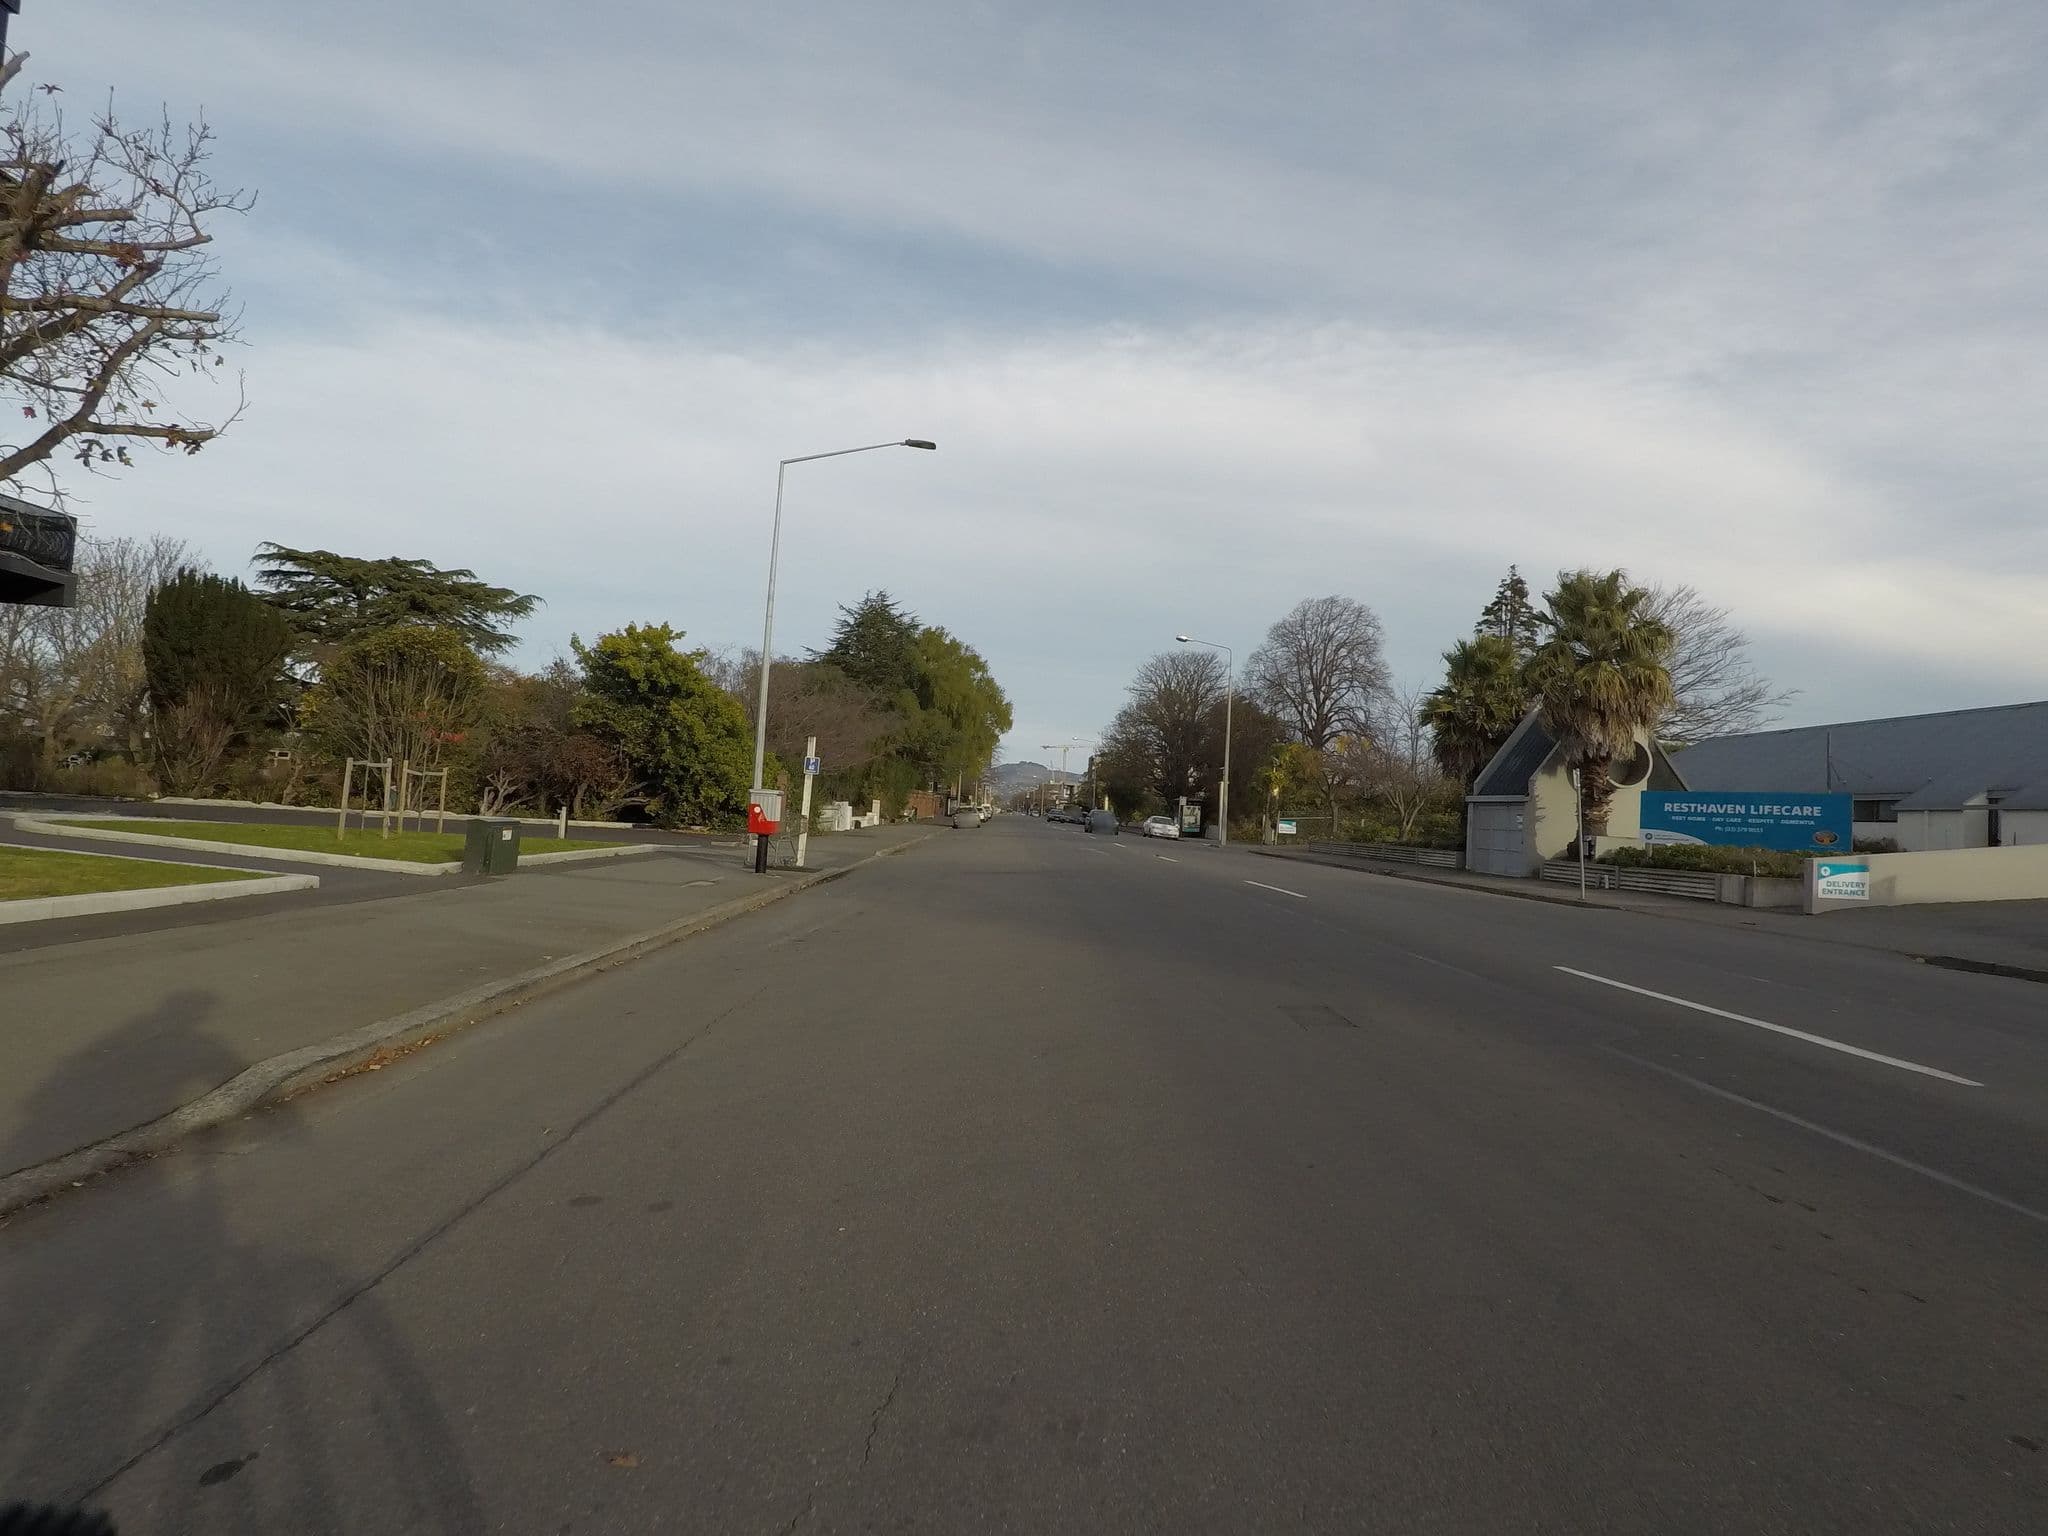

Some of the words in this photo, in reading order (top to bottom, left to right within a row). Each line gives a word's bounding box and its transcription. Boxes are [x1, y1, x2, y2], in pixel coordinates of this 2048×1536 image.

[1664, 802, 1746, 815] RESTHAVEN
[1750, 803, 1822, 817] LIFECARE
[1826, 880, 1866, 889] DELIVERY
[1822, 888, 1866, 897] ENTRANCE
